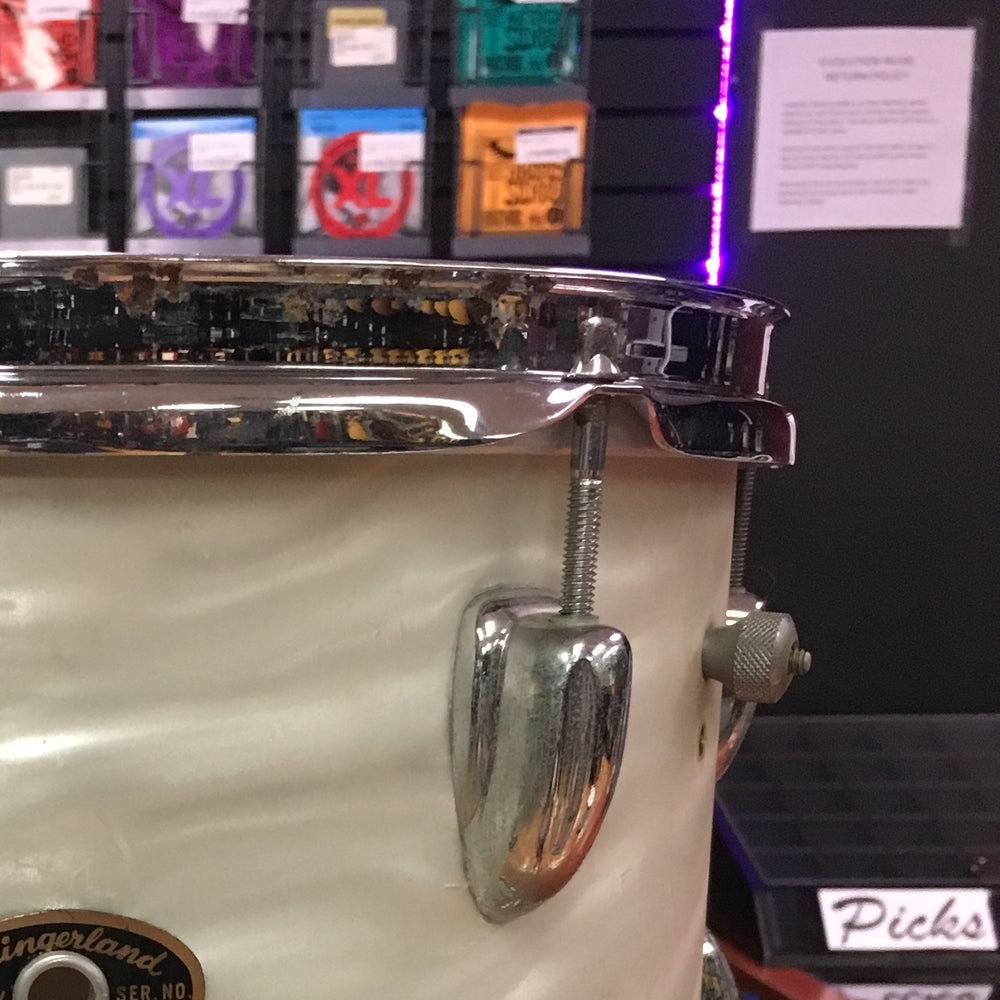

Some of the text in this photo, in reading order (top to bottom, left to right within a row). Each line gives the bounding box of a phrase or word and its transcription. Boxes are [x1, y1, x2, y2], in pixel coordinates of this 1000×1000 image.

[333, 166, 394, 209] XL
[832, 897, 984, 945] Picks
[162, 982, 192, 1000] NO.
